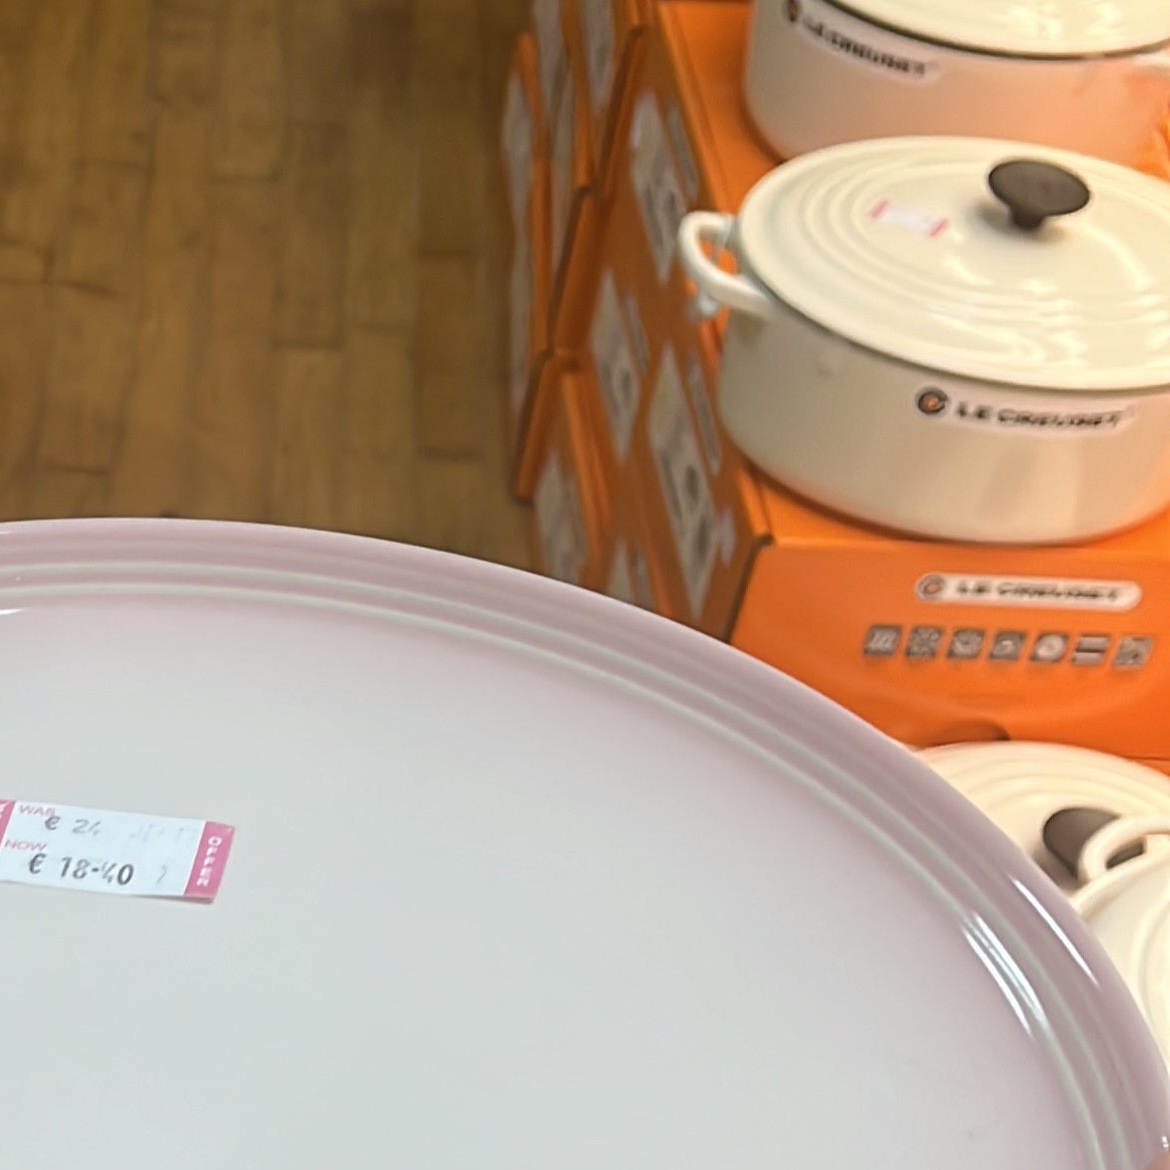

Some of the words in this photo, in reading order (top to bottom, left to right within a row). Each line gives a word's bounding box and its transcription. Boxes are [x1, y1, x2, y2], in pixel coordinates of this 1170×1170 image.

[19, 804, 56, 817] WAS
[4, 839, 47, 852] NOW
[196, 836, 223, 888] OFFER
